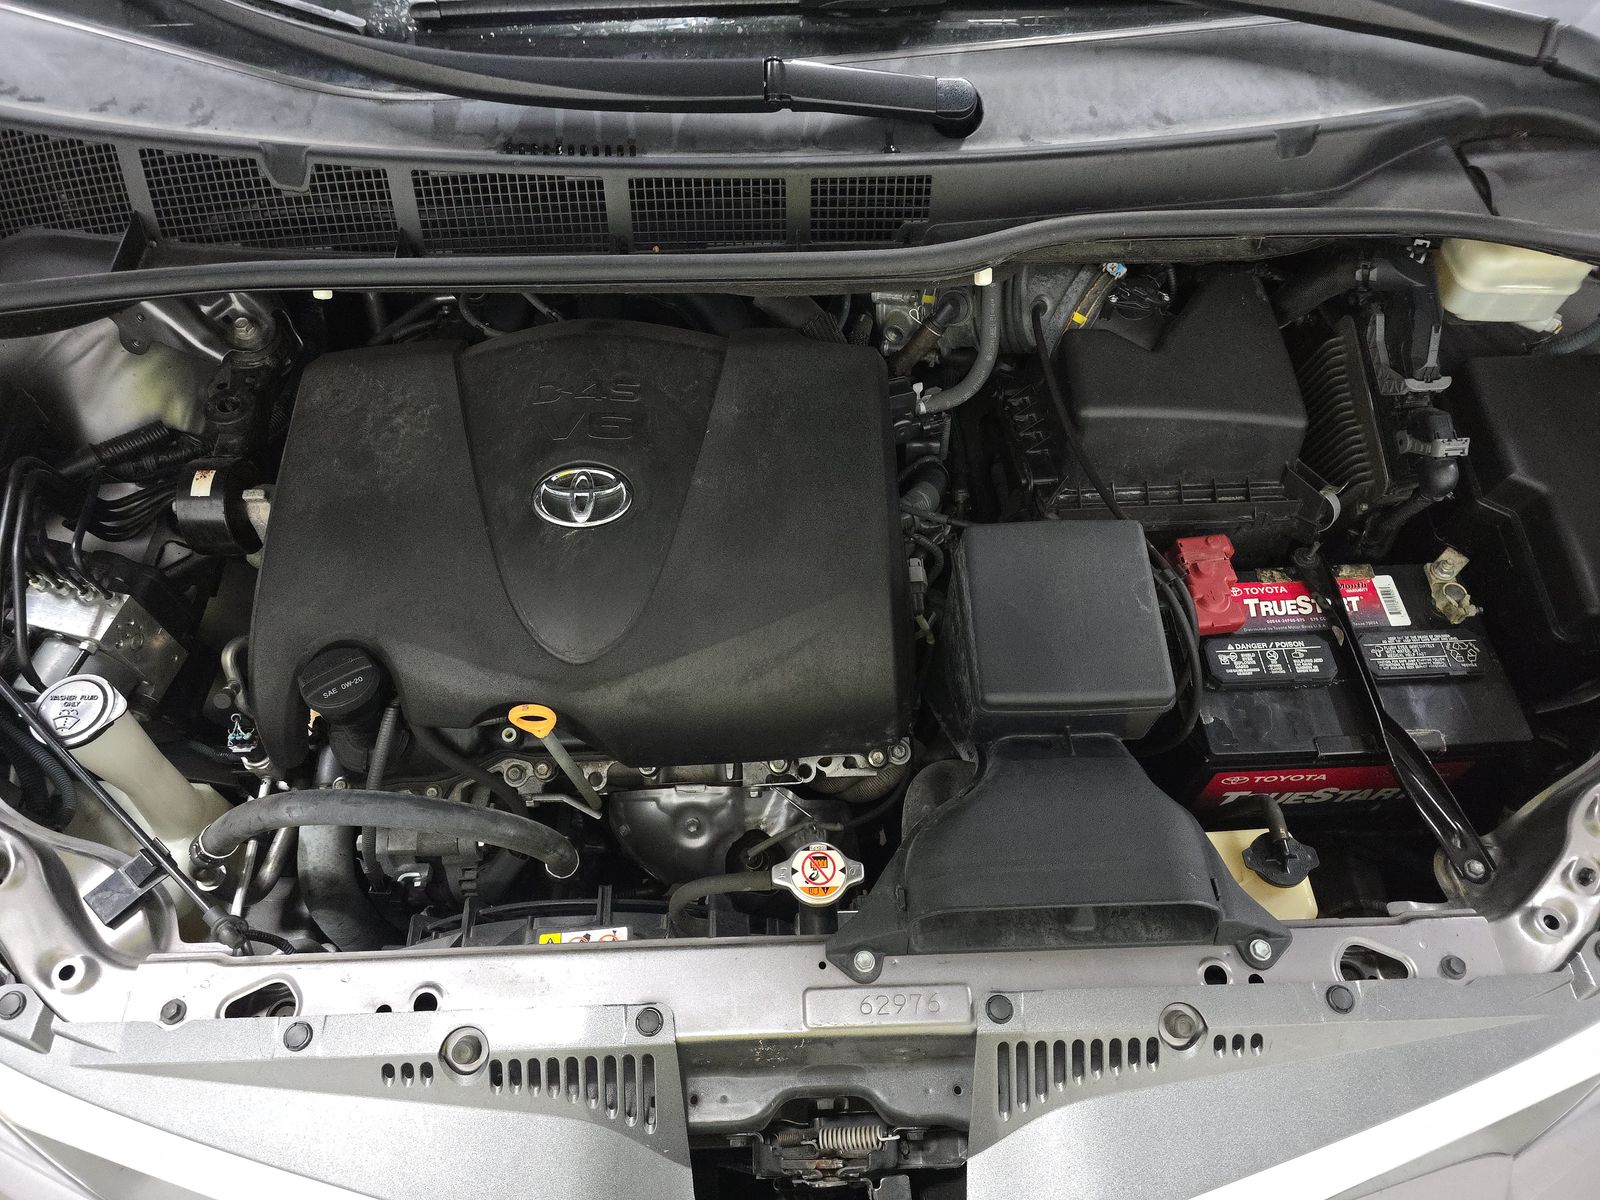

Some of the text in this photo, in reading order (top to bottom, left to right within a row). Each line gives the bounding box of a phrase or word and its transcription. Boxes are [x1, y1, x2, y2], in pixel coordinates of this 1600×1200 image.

[1243, 586, 1288, 595] TOYOTA
[322, 676, 363, 698] SAE 0W-20
[1253, 774, 1327, 783] TOYOTA
[860, 993, 940, 1015] 62976
